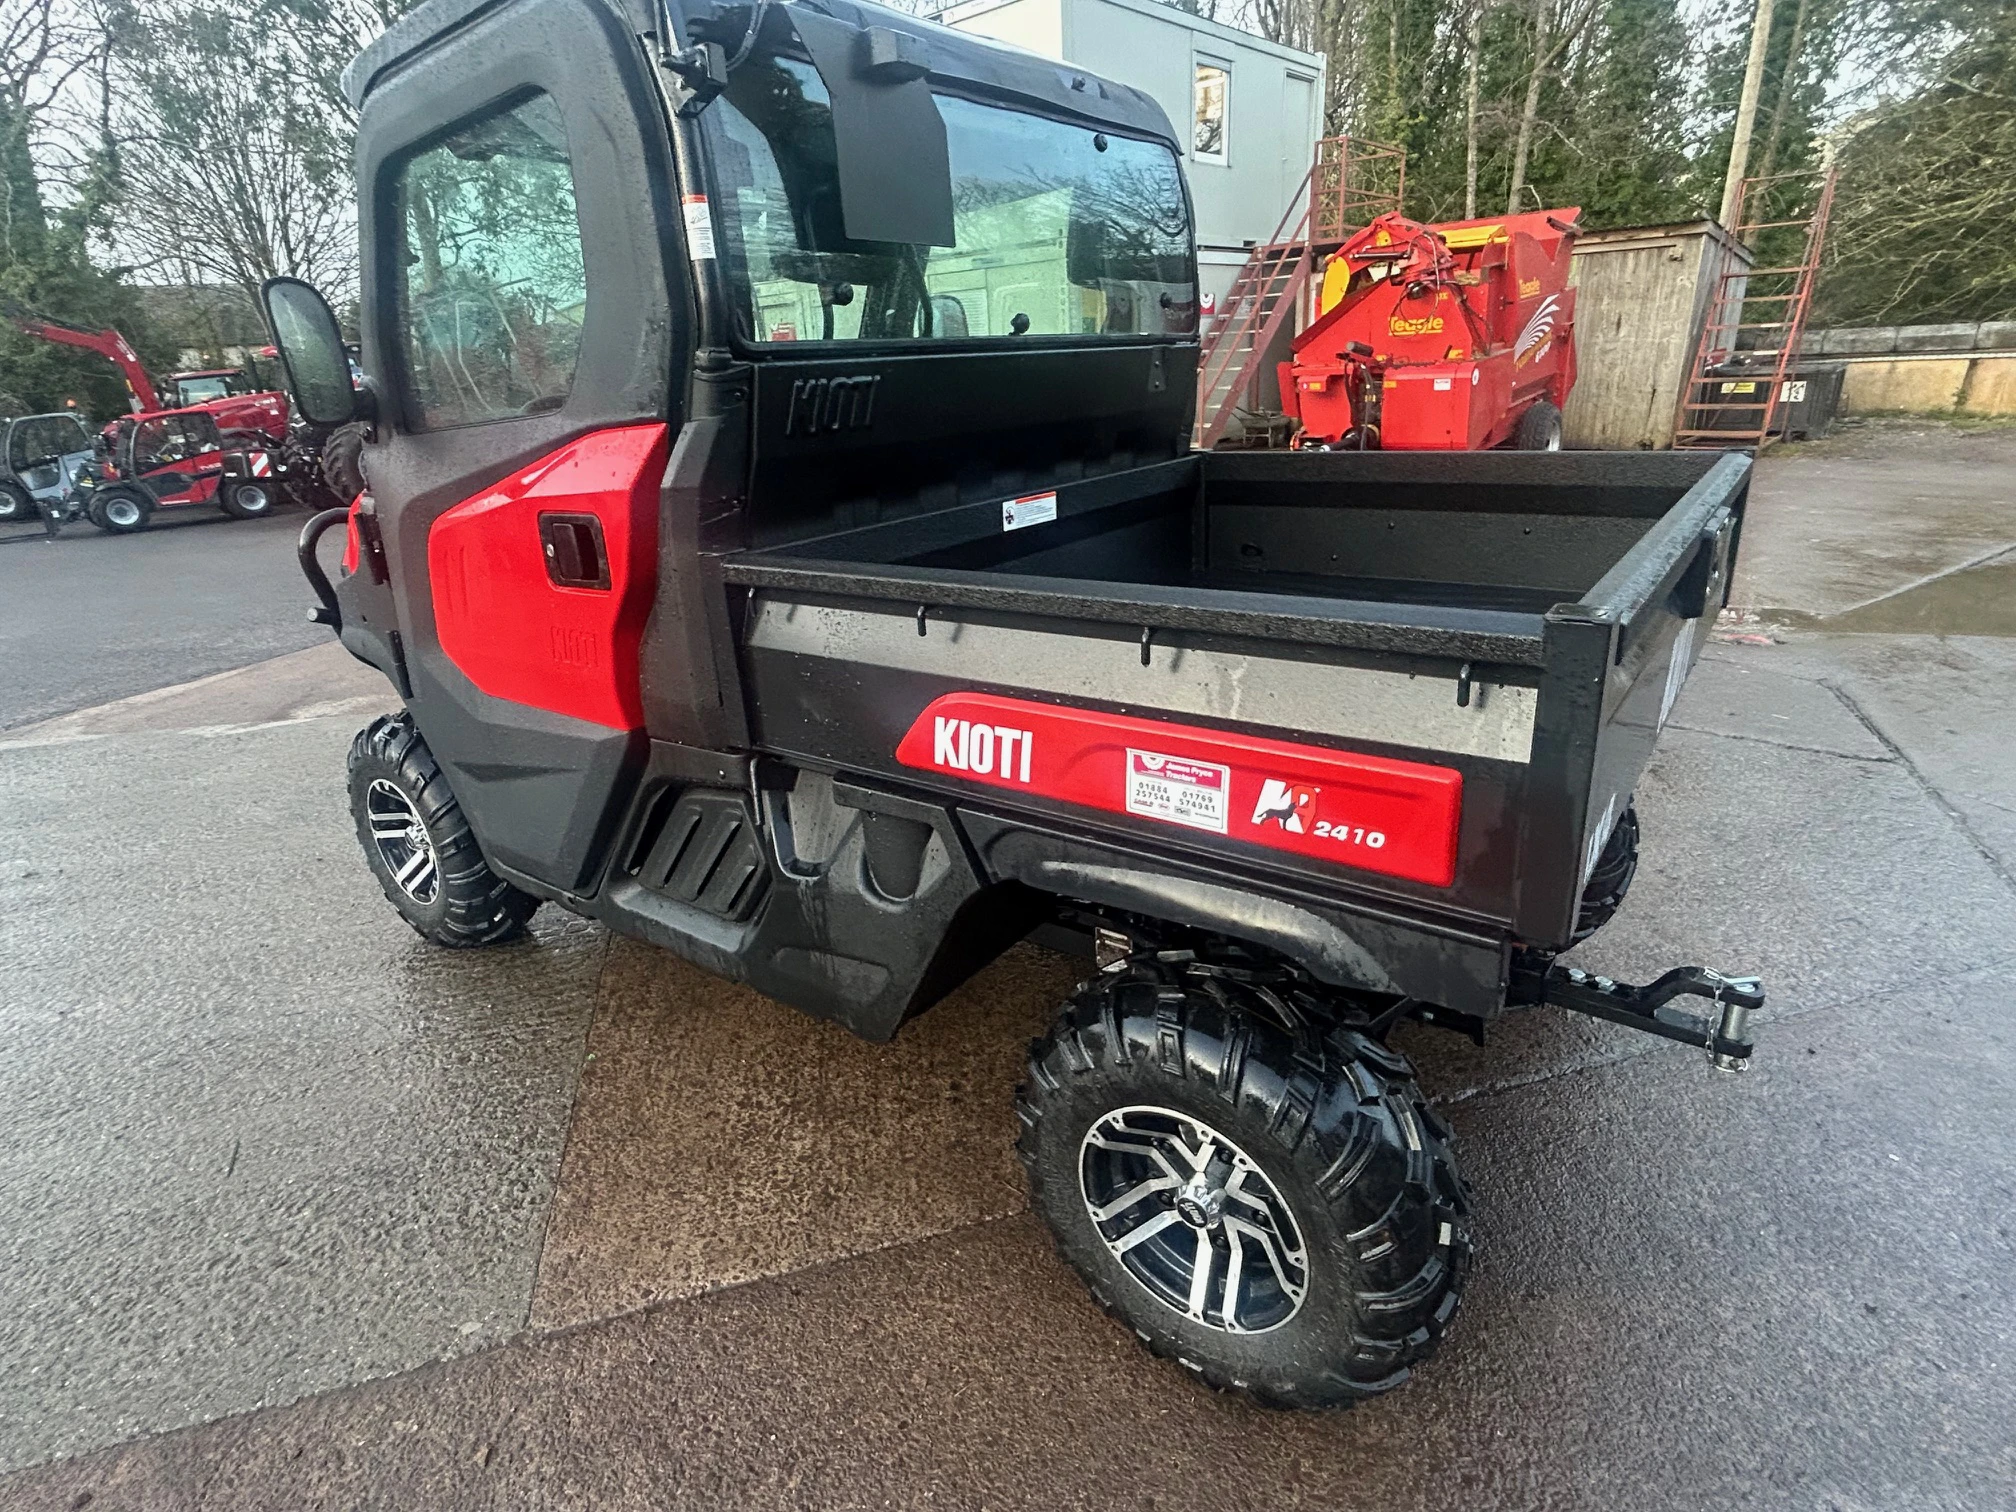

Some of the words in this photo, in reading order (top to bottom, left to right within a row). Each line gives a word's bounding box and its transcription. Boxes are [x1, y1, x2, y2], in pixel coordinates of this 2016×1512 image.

[1388, 315, 1444, 335] Teagle
[934, 715, 1033, 783] KIOTI
[1139, 782, 1168, 794] 01884
[1136, 789, 1171, 803] 257544
[1182, 791, 1213, 804] 01769
[1179, 798, 1216, 813] 574941
[1313, 820, 1386, 849] 2410
